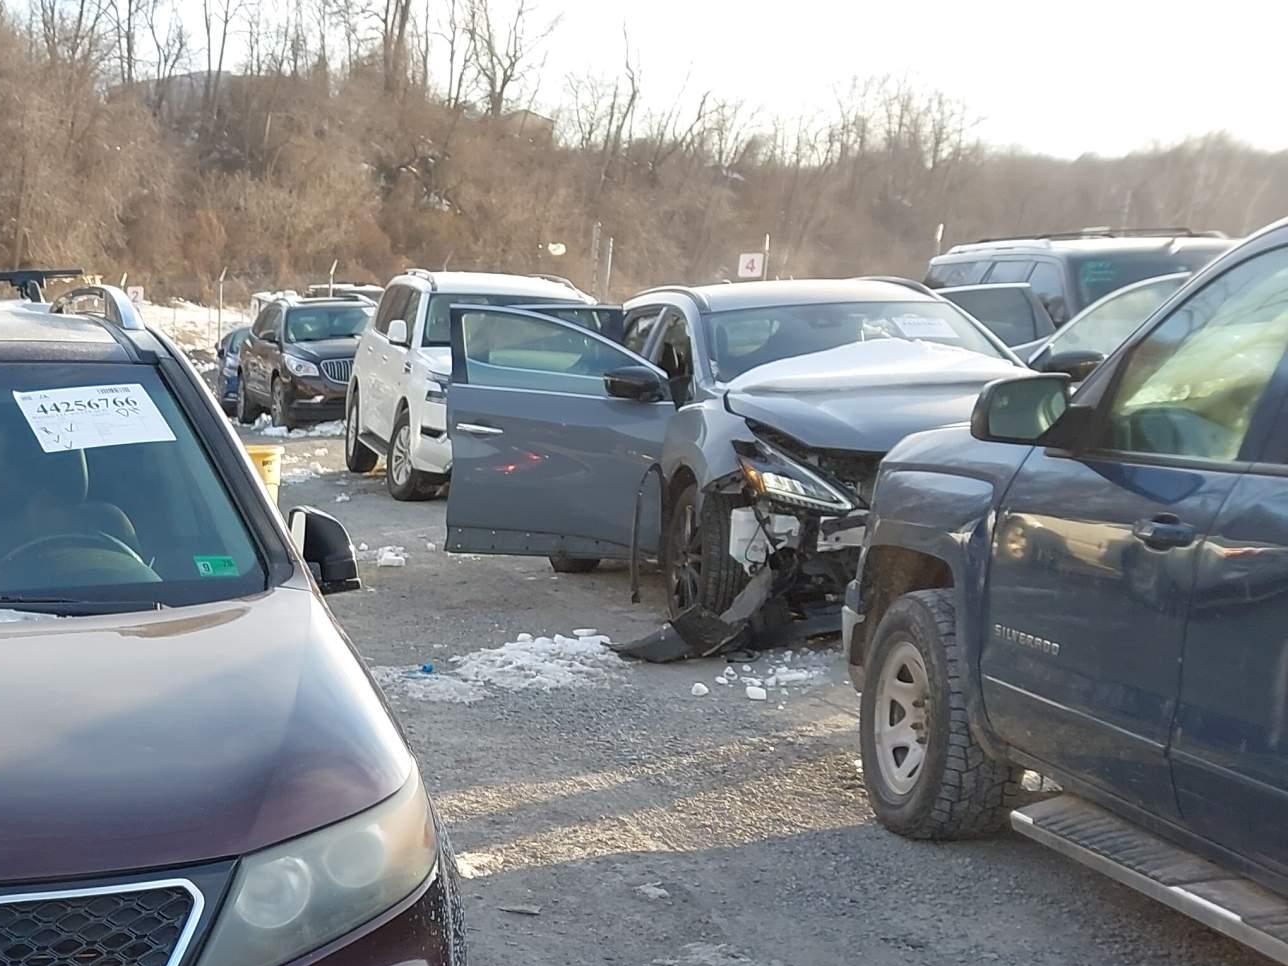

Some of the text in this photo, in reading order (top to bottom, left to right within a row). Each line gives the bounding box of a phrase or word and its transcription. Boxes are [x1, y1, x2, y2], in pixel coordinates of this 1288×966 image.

[745, 258, 756, 273] 4
[132, 290, 139, 303] 2
[36, 397, 138, 415] 44256766
[994, 623, 1060, 655] SILVERADO
